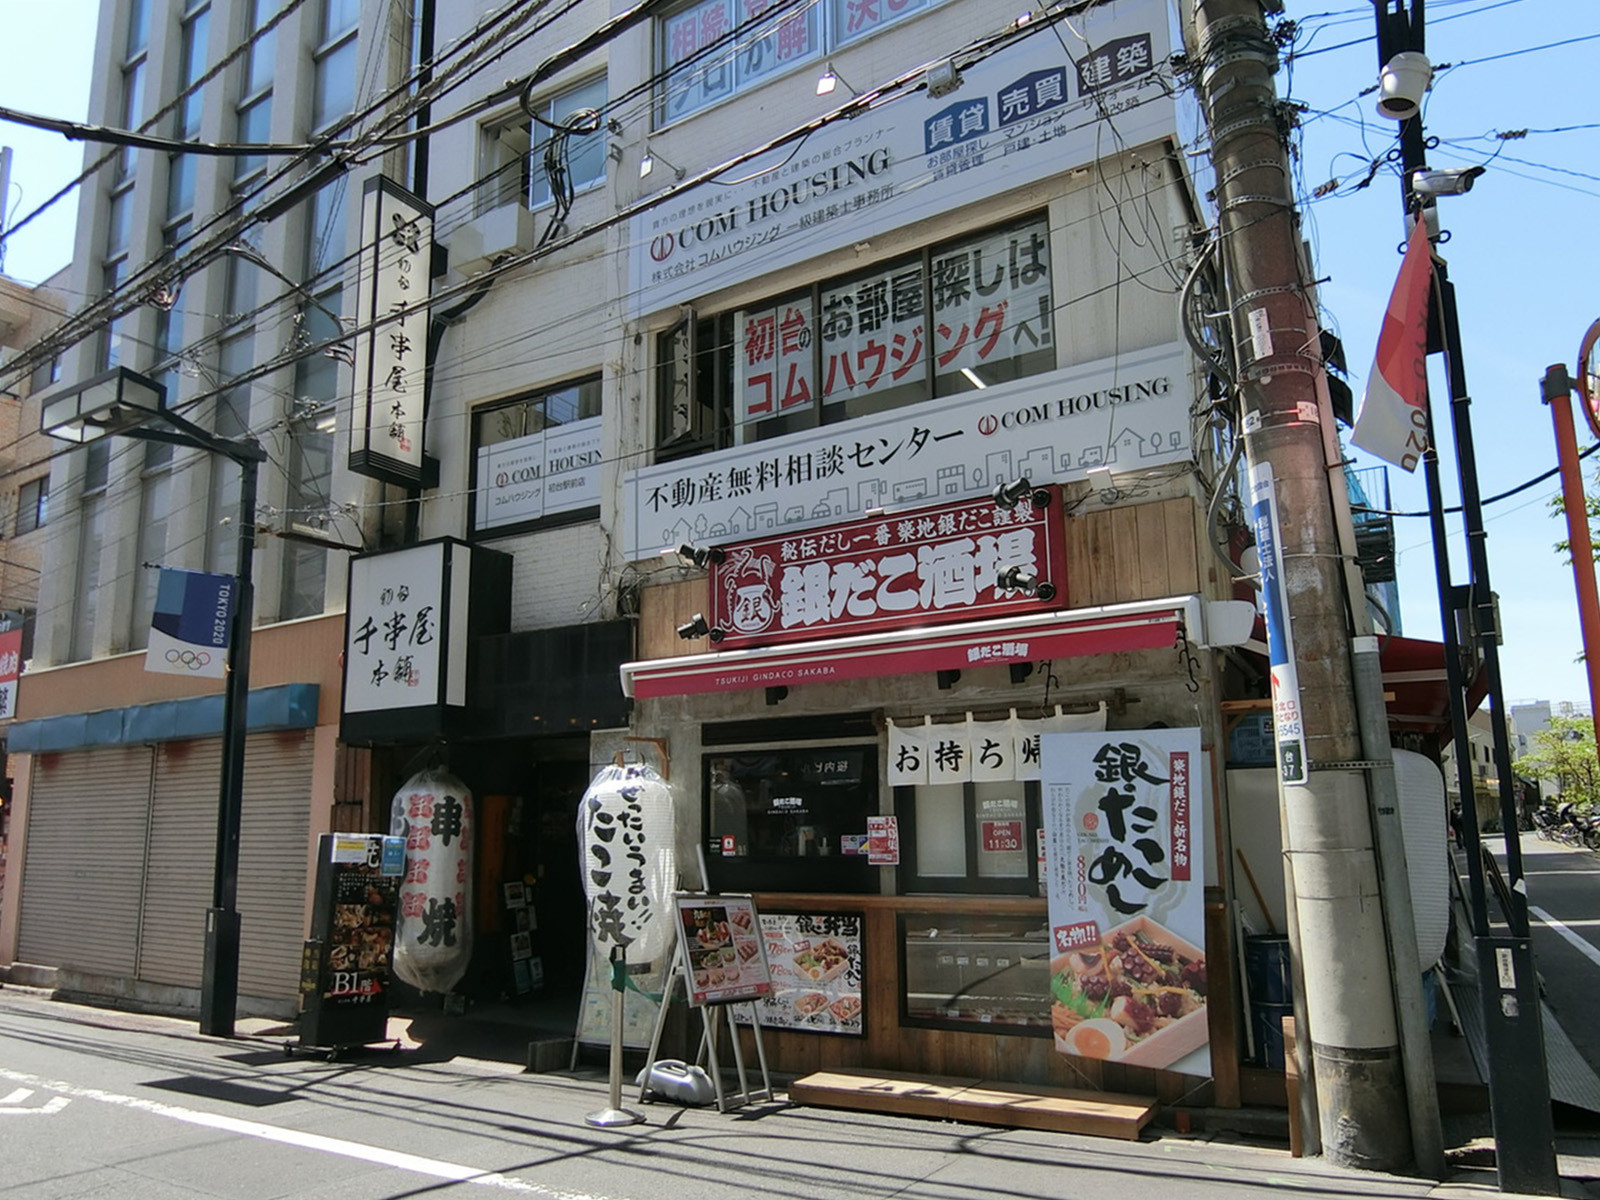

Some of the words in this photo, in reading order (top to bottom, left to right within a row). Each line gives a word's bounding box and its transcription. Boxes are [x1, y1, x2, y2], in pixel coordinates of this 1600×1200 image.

[1080, 39, 1149, 90] 建築
[1001, 72, 1063, 121] 売買
[927, 103, 986, 149] 賃貸
[1003, 110, 1066, 139] マンション
[926, 138, 990, 169] お部屋探し
[678, 207, 738, 249] COM
[746, 146, 892, 225] HOUSING
[697, 223, 782, 268] コムハウジング
[1001, 402, 1050, 430] COM
[1058, 376, 1169, 418] HOUSING
[511, 464, 542, 484] COM
[644, 426, 965, 514] 不動産無料相談センター
[780, 525, 892, 563] 秘伝だし一番
[779, 527, 1037, 629] 銀だこ酒場
[216, 584, 231, 618] TOKYO
[737, 596, 767, 624] 銀
[212, 618, 226, 645] 2020
[967, 641, 1029, 663] 銀だこ酒場
[715, 676, 750, 686] TSUKIJI
[752, 671, 794, 682] GINDACO
[797, 666, 836, 678] SAKABA
[1172, 758, 1188, 868] 築地銀だこ新名物
[988, 838, 1018, 849] 11:30
[992, 829, 1011, 837] OPEN
[416, 795, 463, 948] 串焼
